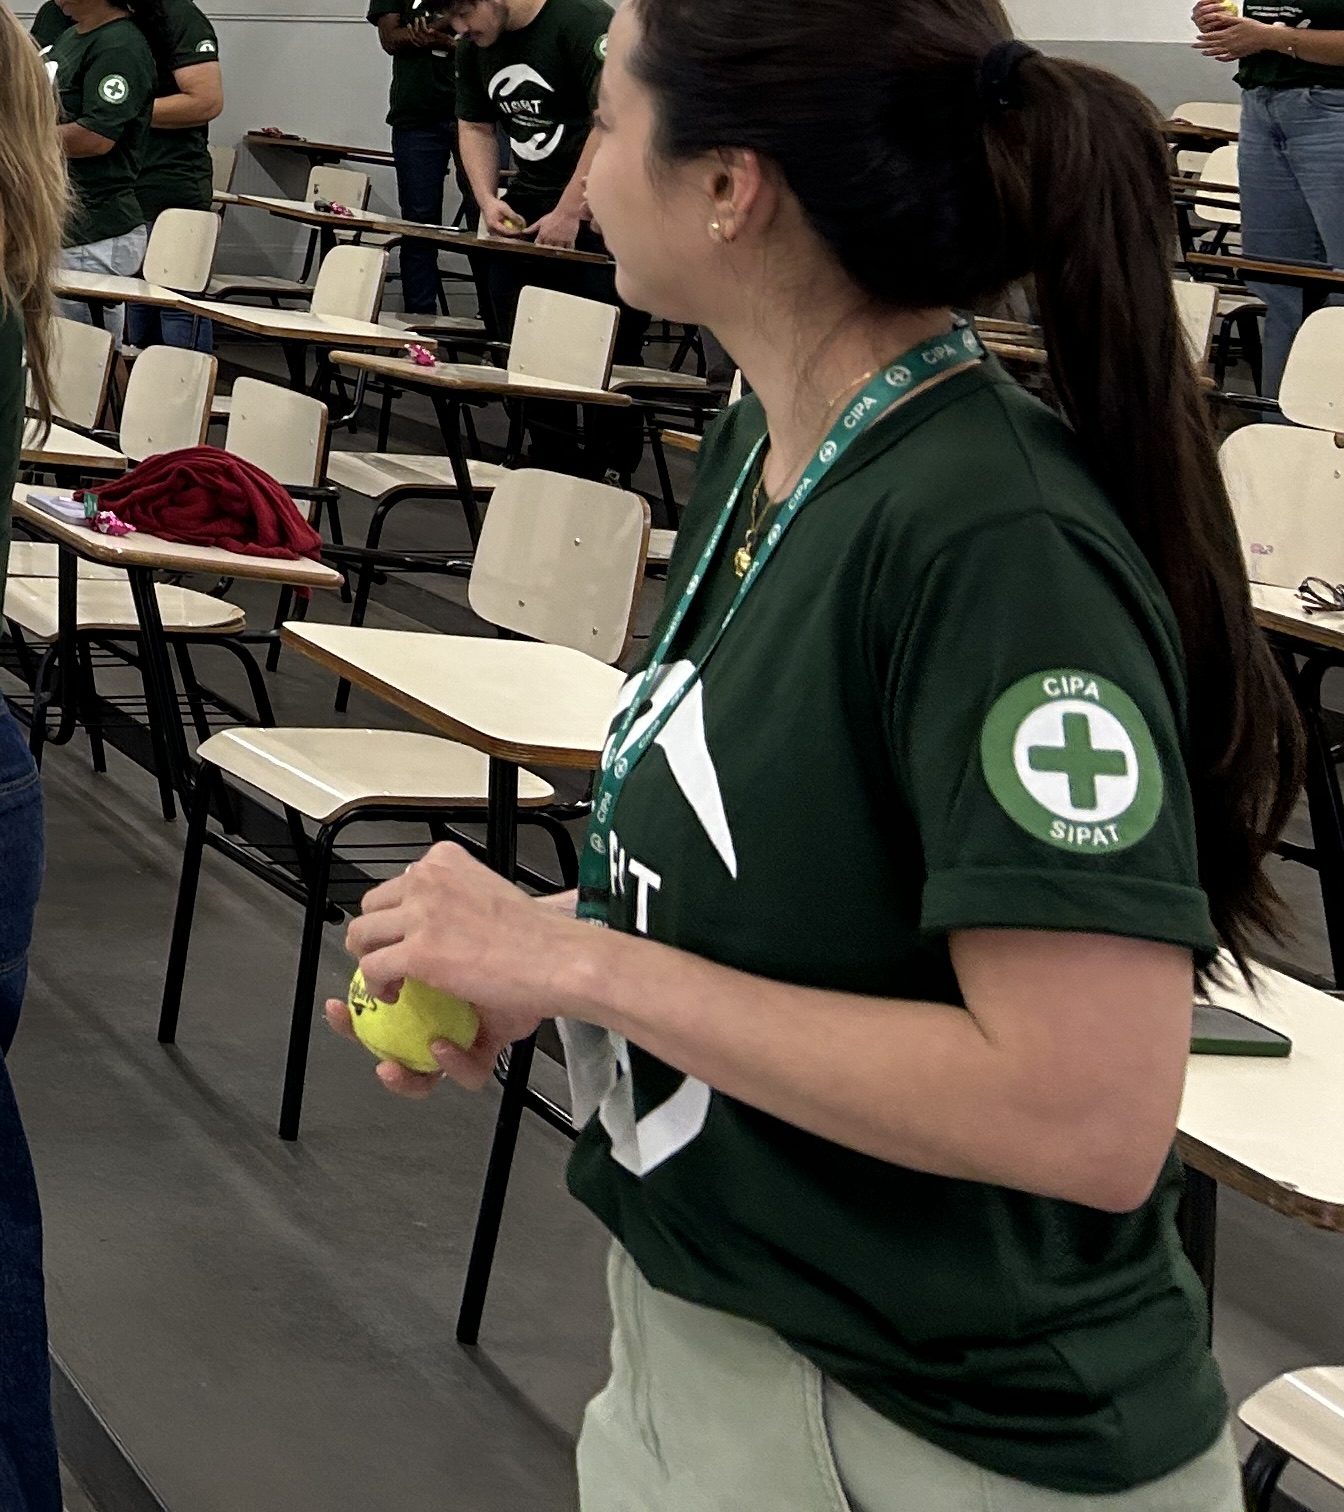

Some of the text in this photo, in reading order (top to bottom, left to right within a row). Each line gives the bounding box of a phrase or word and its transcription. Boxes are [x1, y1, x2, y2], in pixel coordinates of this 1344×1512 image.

[843, 395, 878, 429] CIPA
[787, 476, 813, 511] CIPA
[1042, 676, 1100, 700] CIPA
[1049, 820, 1119, 846] SIPAT
